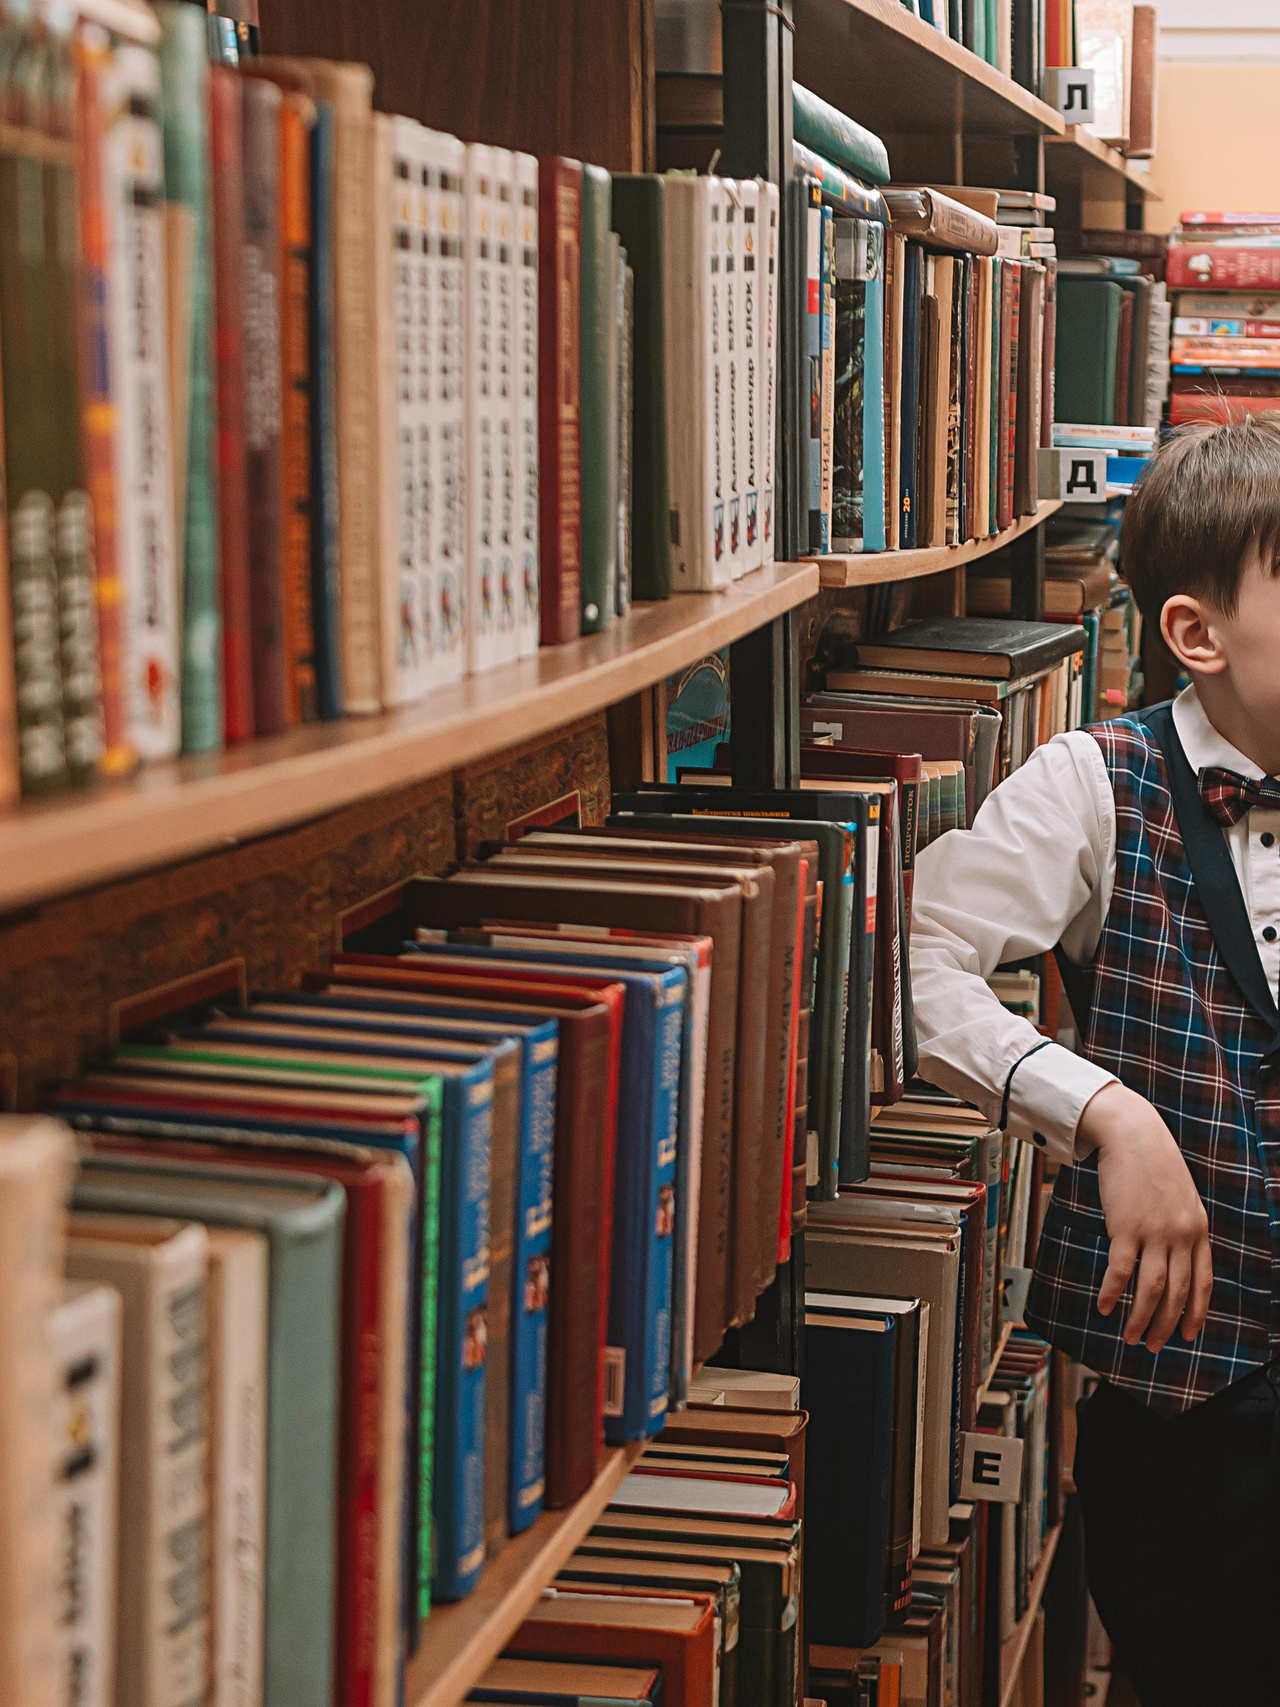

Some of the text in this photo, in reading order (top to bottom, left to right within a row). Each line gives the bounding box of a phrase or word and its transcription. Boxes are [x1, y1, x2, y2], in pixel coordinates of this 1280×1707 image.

[1063, 83, 1089, 111] Л
[745, 281, 755, 487] Александр БЛОК
[1066, 459, 1098, 495] Д
[903, 496, 911, 513] 20
[904, 789, 915, 865] ПОДРОСТОК
[971, 1450, 1002, 1486] Е
